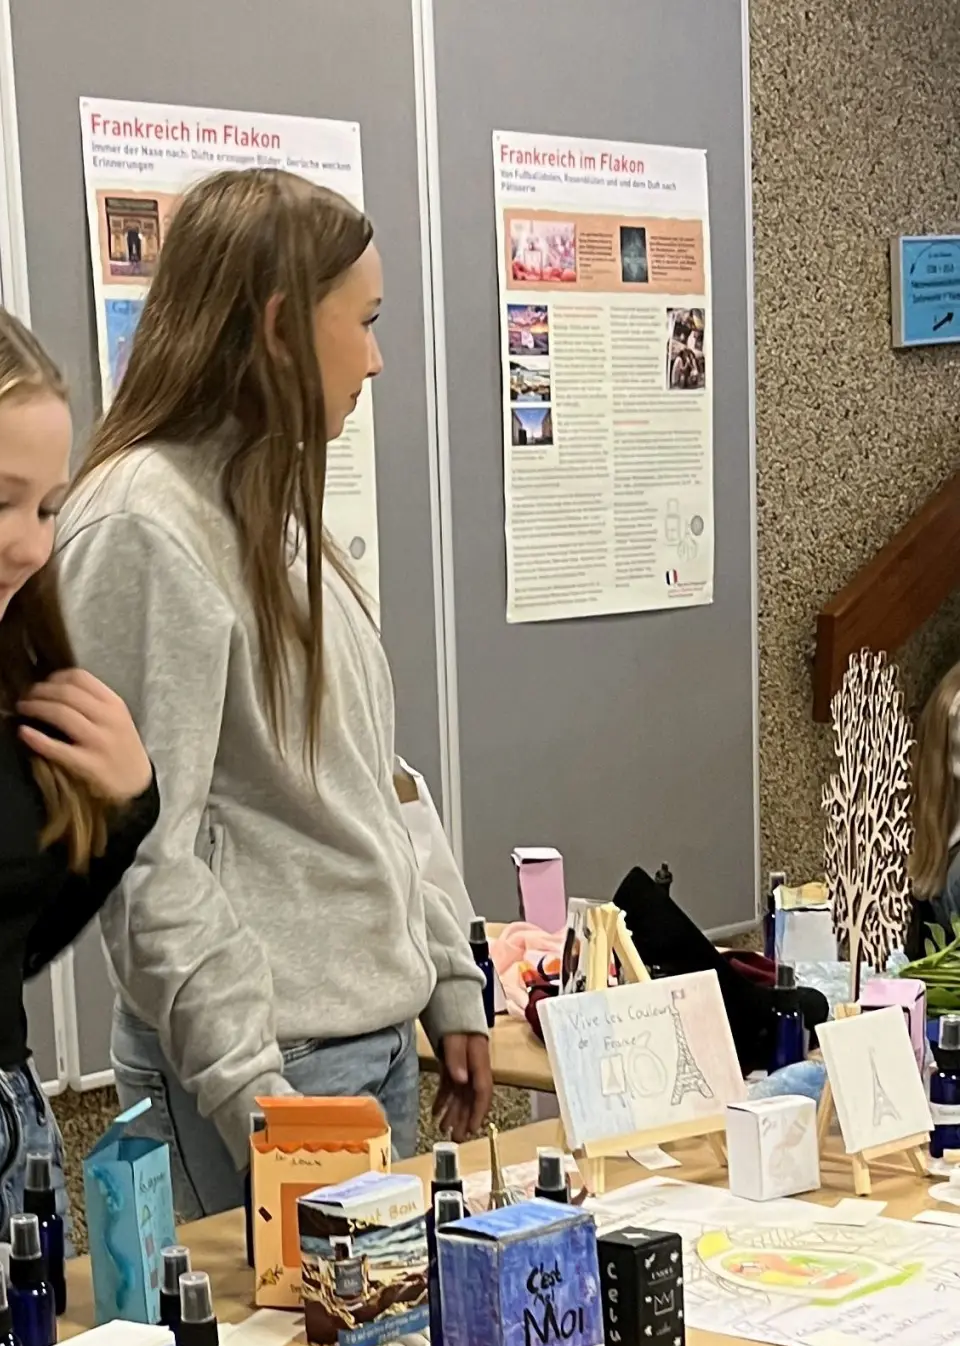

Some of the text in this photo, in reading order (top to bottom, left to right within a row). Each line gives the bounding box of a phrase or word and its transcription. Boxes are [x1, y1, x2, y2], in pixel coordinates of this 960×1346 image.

[90, 112, 281, 149] Frankreich im Flakon
[500, 145, 645, 174] Frankreich im Flakon
